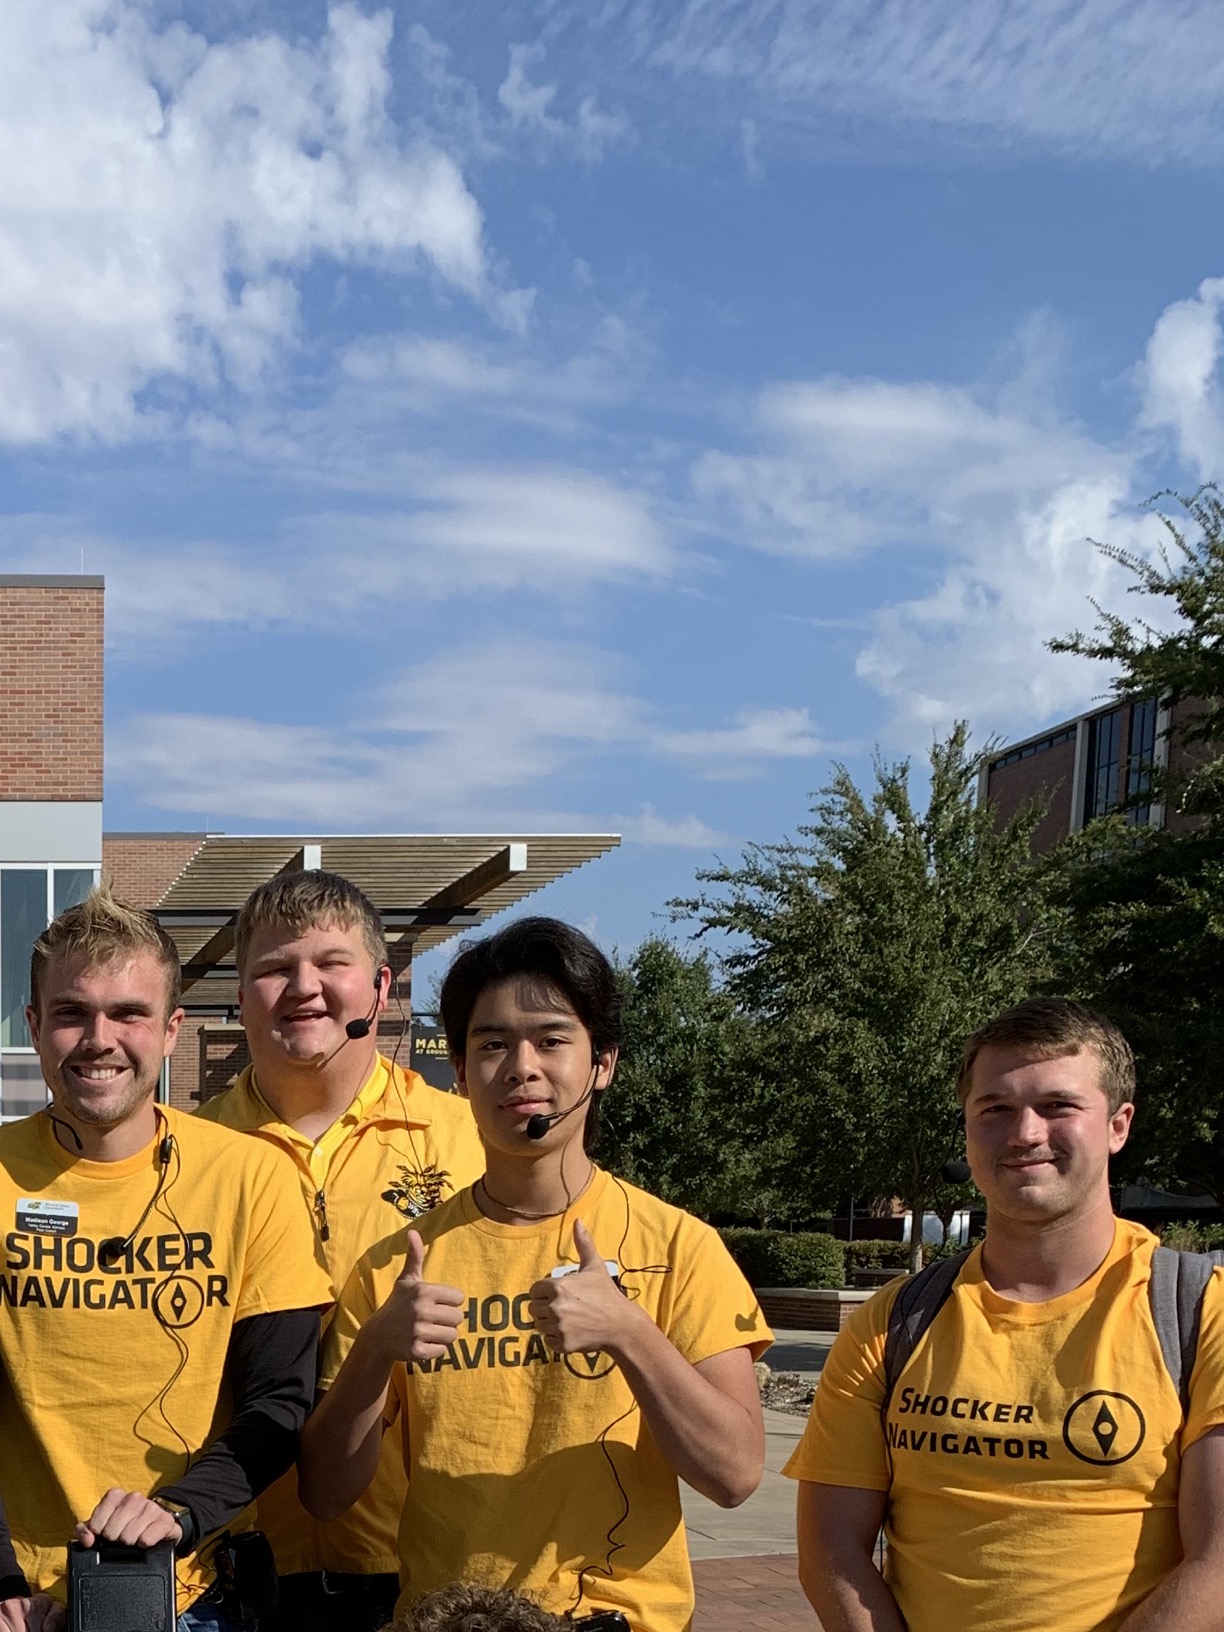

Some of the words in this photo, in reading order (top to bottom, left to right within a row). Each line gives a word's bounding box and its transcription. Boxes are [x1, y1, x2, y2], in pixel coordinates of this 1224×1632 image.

[48, 1218, 69, 1226] George
[6, 1231, 215, 1275] SHOCKER
[898, 1387, 1034, 1424] SHOCKER
[888, 1422, 1050, 1460] NAVIGATOR
